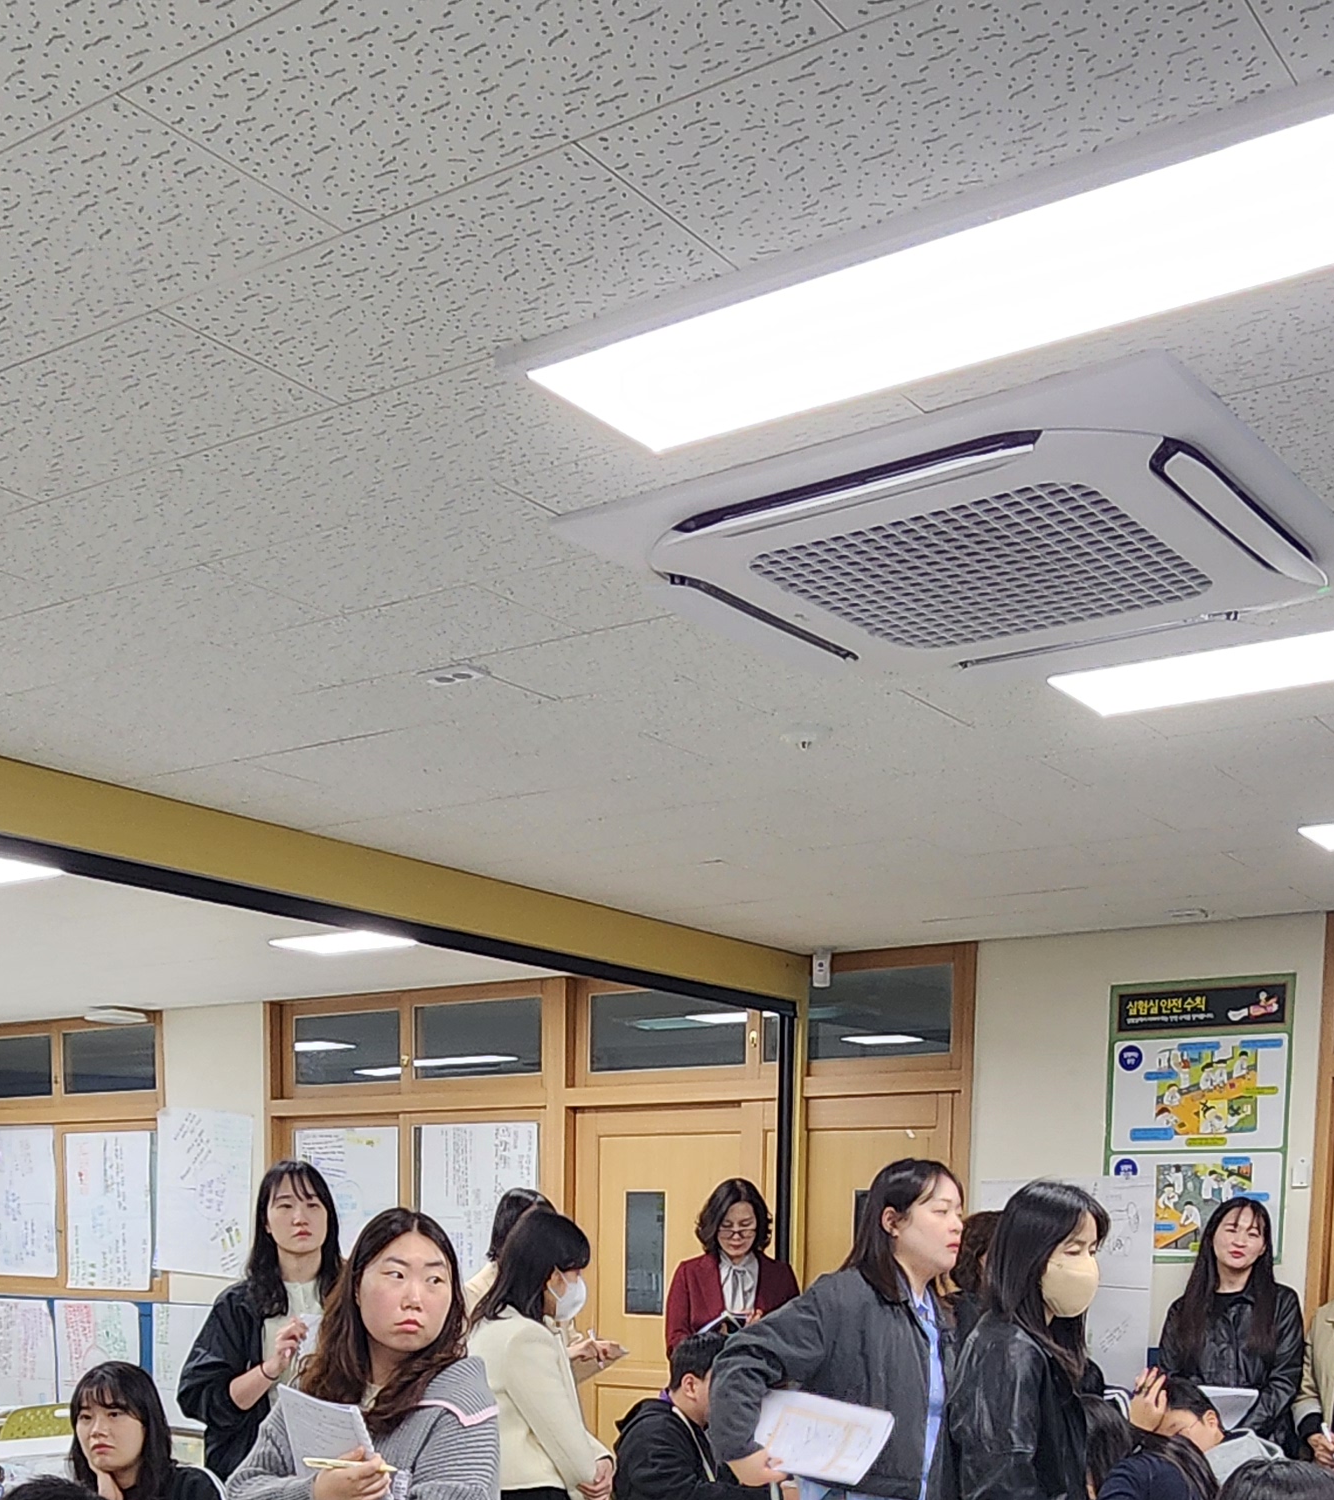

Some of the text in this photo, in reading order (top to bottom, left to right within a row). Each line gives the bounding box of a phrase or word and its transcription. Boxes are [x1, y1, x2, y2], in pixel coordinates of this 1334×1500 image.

[1126, 996, 1207, 1016] 실험실 안전 수칙
